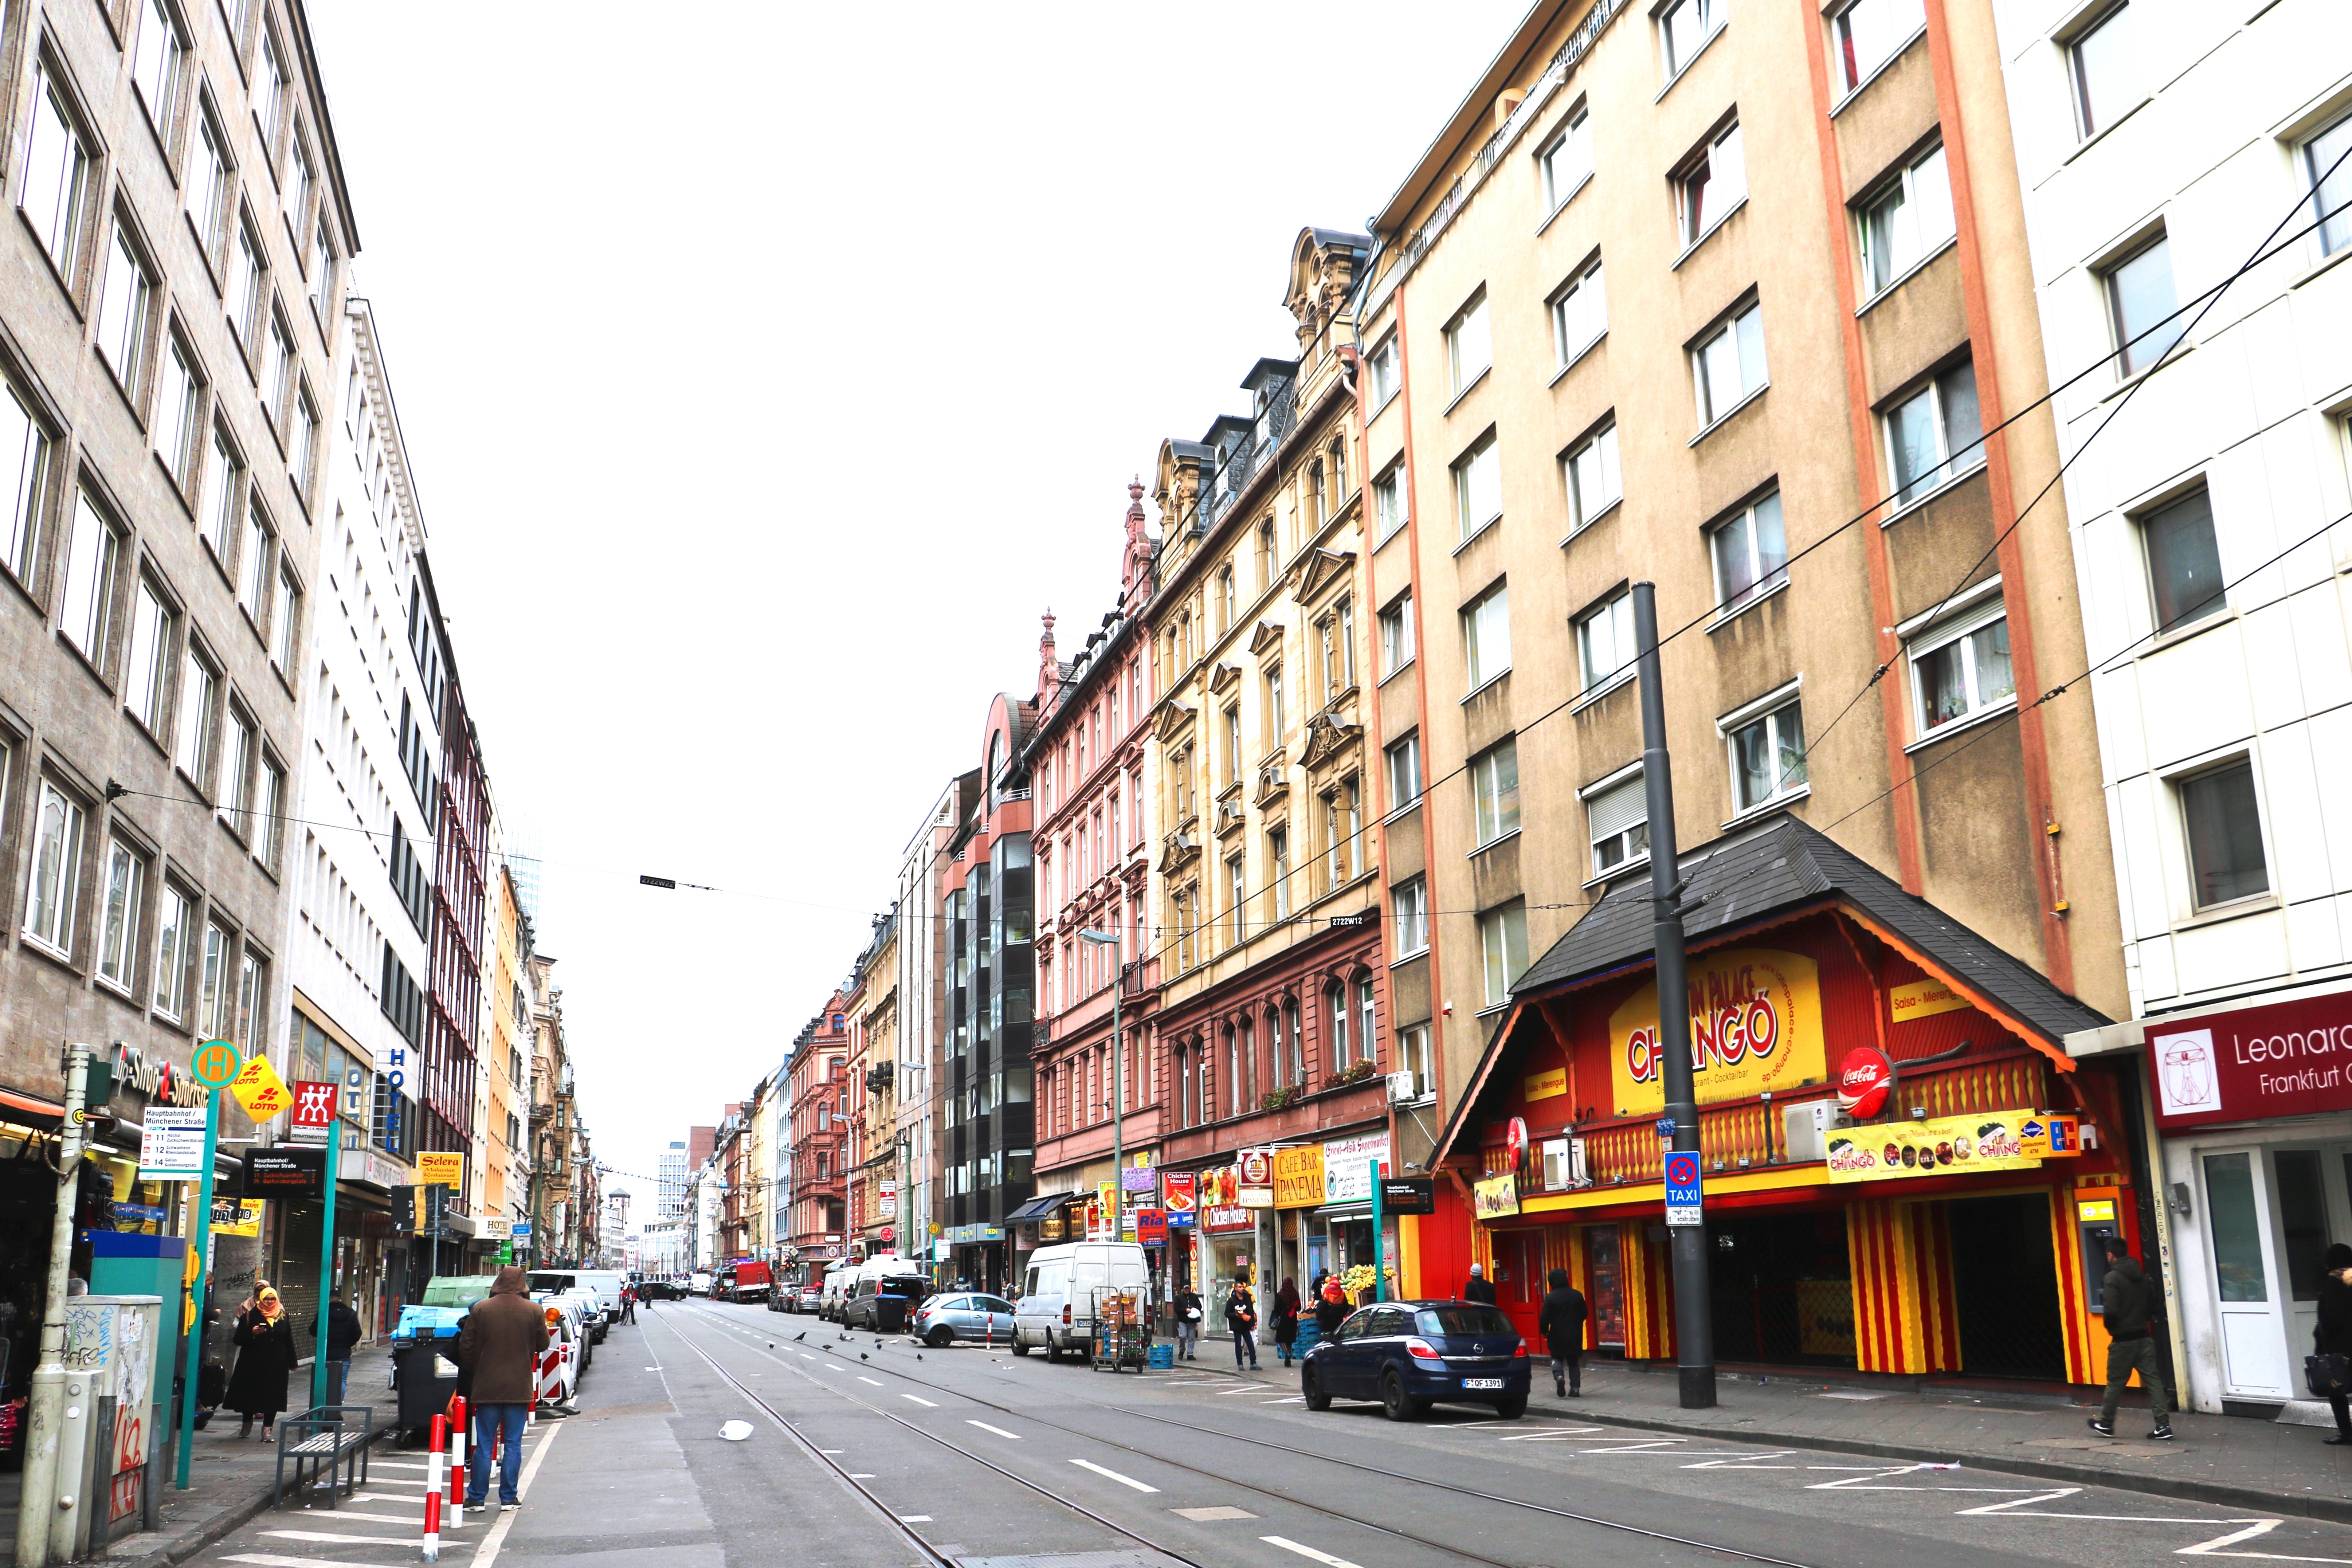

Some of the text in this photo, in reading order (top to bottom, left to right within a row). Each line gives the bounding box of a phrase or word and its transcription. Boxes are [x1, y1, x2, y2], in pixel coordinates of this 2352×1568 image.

[1333, 917, 1362, 926] 2722W12
[1708, 964, 1756, 1012] PALACE
[1895, 997, 1916, 1010] Salsa
[1627, 987, 1778, 1083] CHNGÓ
[206, 1051, 227, 1077] H
[161, 1061, 170, 1100] &
[1542, 1078, 1564, 1089] Merengue
[1714, 1070, 1748, 1083] Cocktailbar
[2260, 1065, 2339, 1094] Frankfurt
[249, 1102, 278, 1111] LOTTO
[386, 1049, 405, 1152] HOTEL
[1358, 1134, 1388, 1153] Supermarket
[422, 1156, 458, 1166] Selera
[1276, 1175, 1323, 1203] IPANEMA
[1669, 1190, 1697, 1201] TAXI
[1139, 1211, 1163, 1226] Ria
[1210, 1205, 1247, 1226] Chicken House
[487, 1221, 507, 1229] HOTEL
[1236, 1256, 1247, 1266] HALAL
